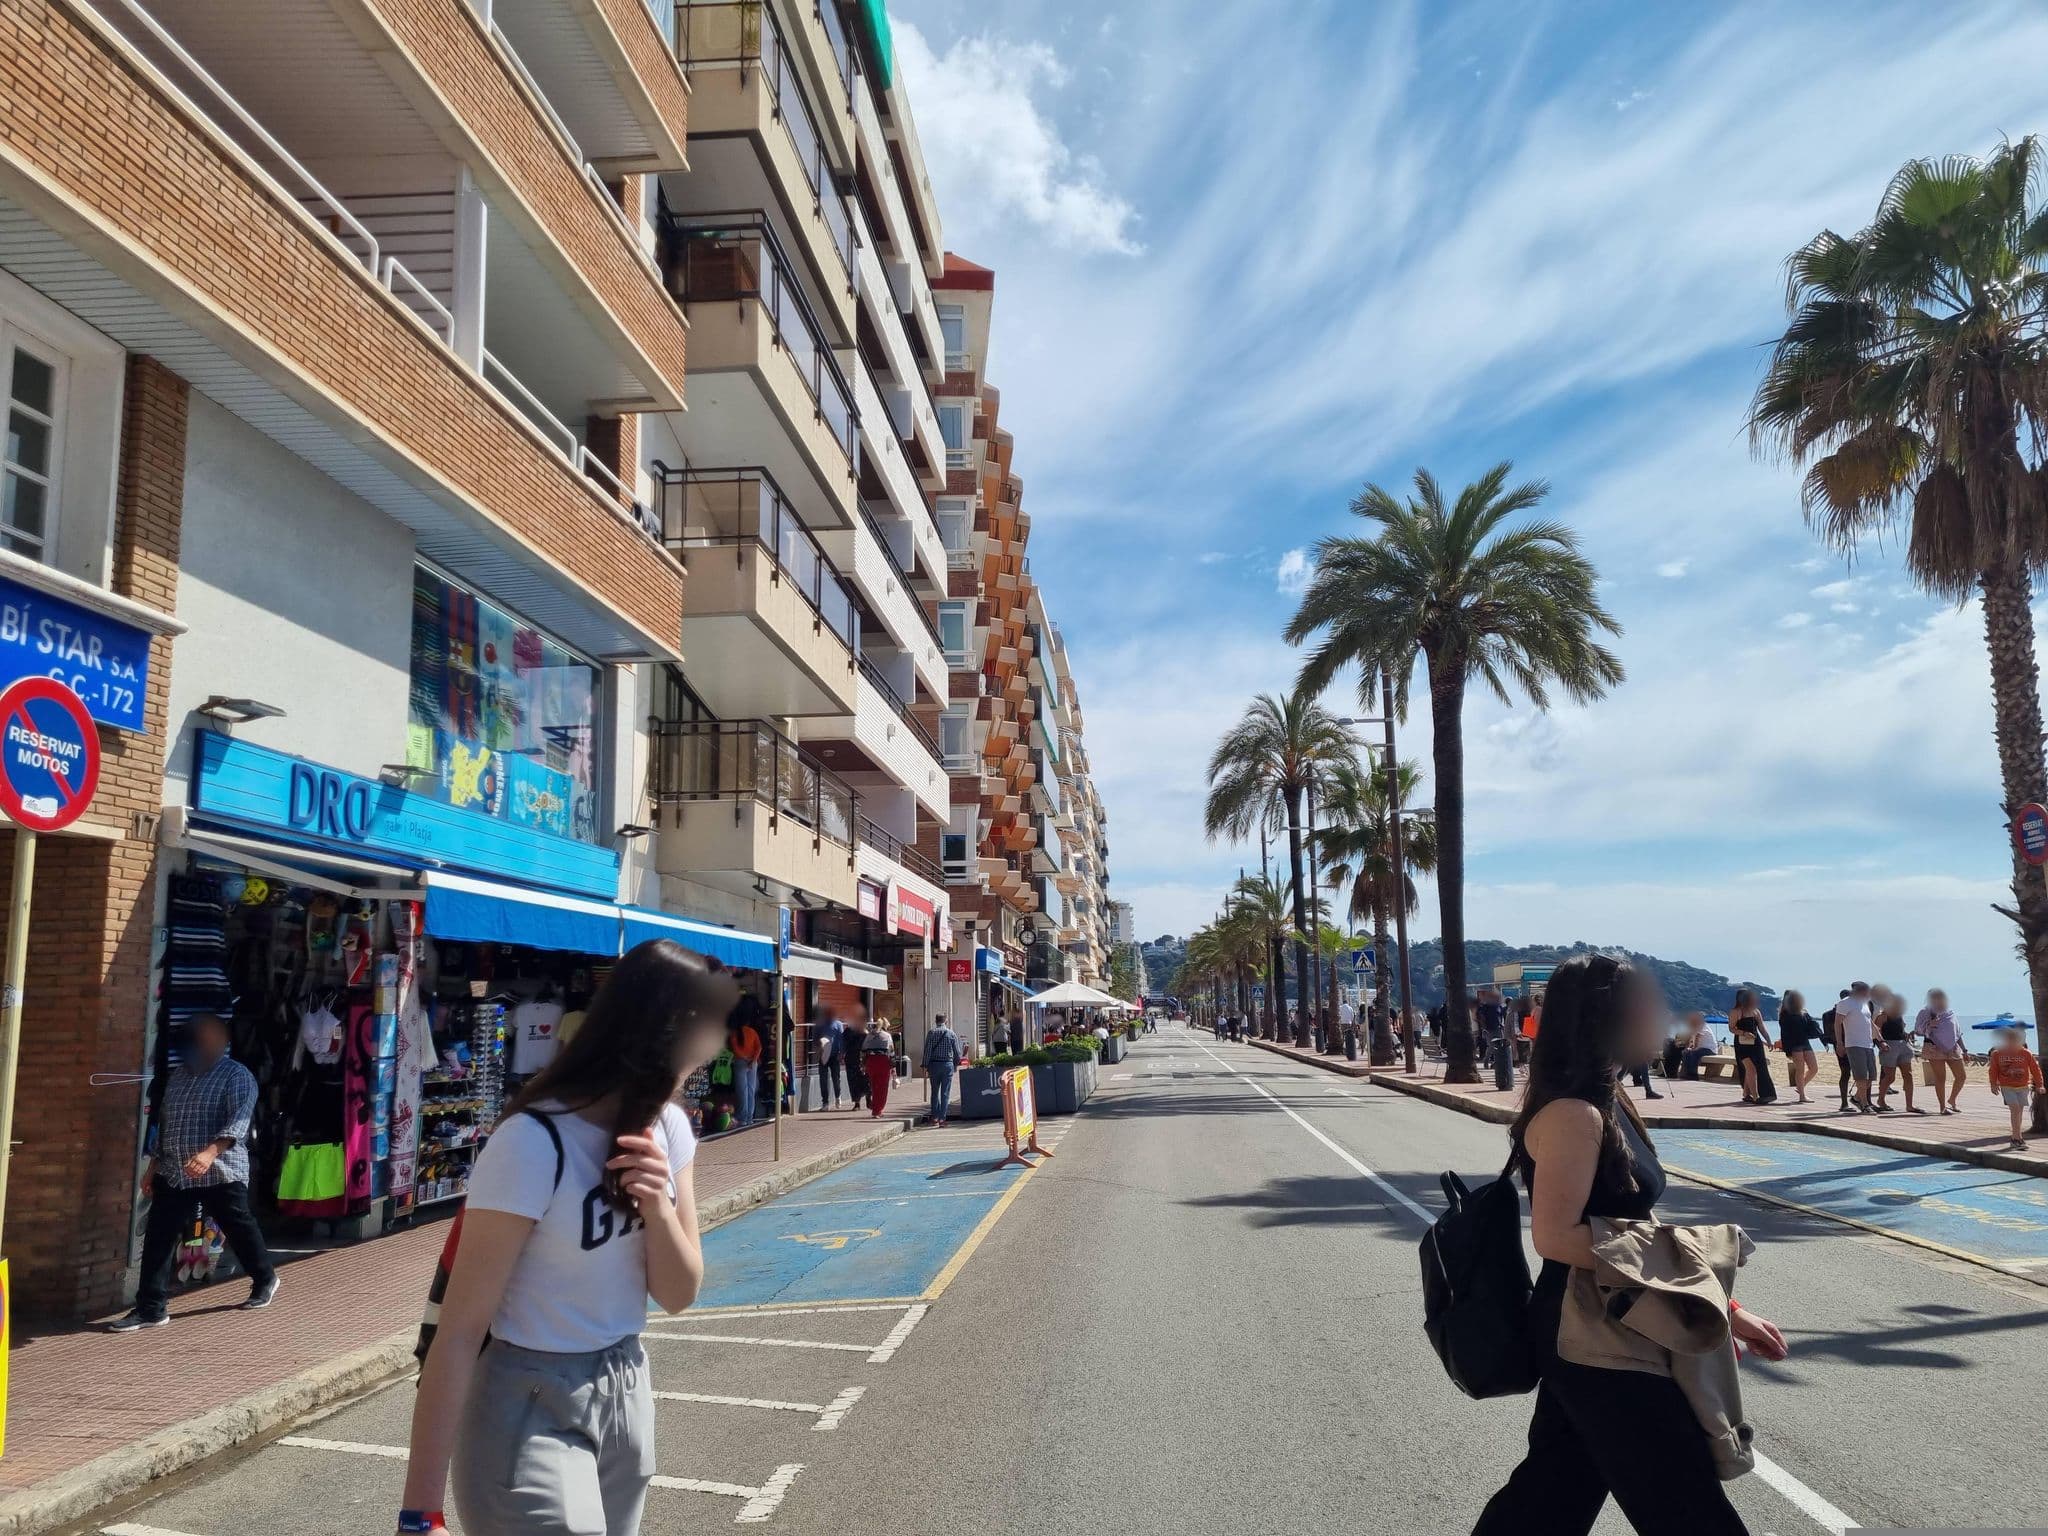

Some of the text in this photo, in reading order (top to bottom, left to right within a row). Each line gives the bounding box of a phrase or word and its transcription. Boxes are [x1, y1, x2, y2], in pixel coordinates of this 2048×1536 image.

[1, 603, 32, 646] BÍ
[37, 618, 103, 671] STAR
[9, 725, 82, 759] RESERVAT
[18, 748, 70, 776] MOTOS
[132, 811, 161, 841] 17
